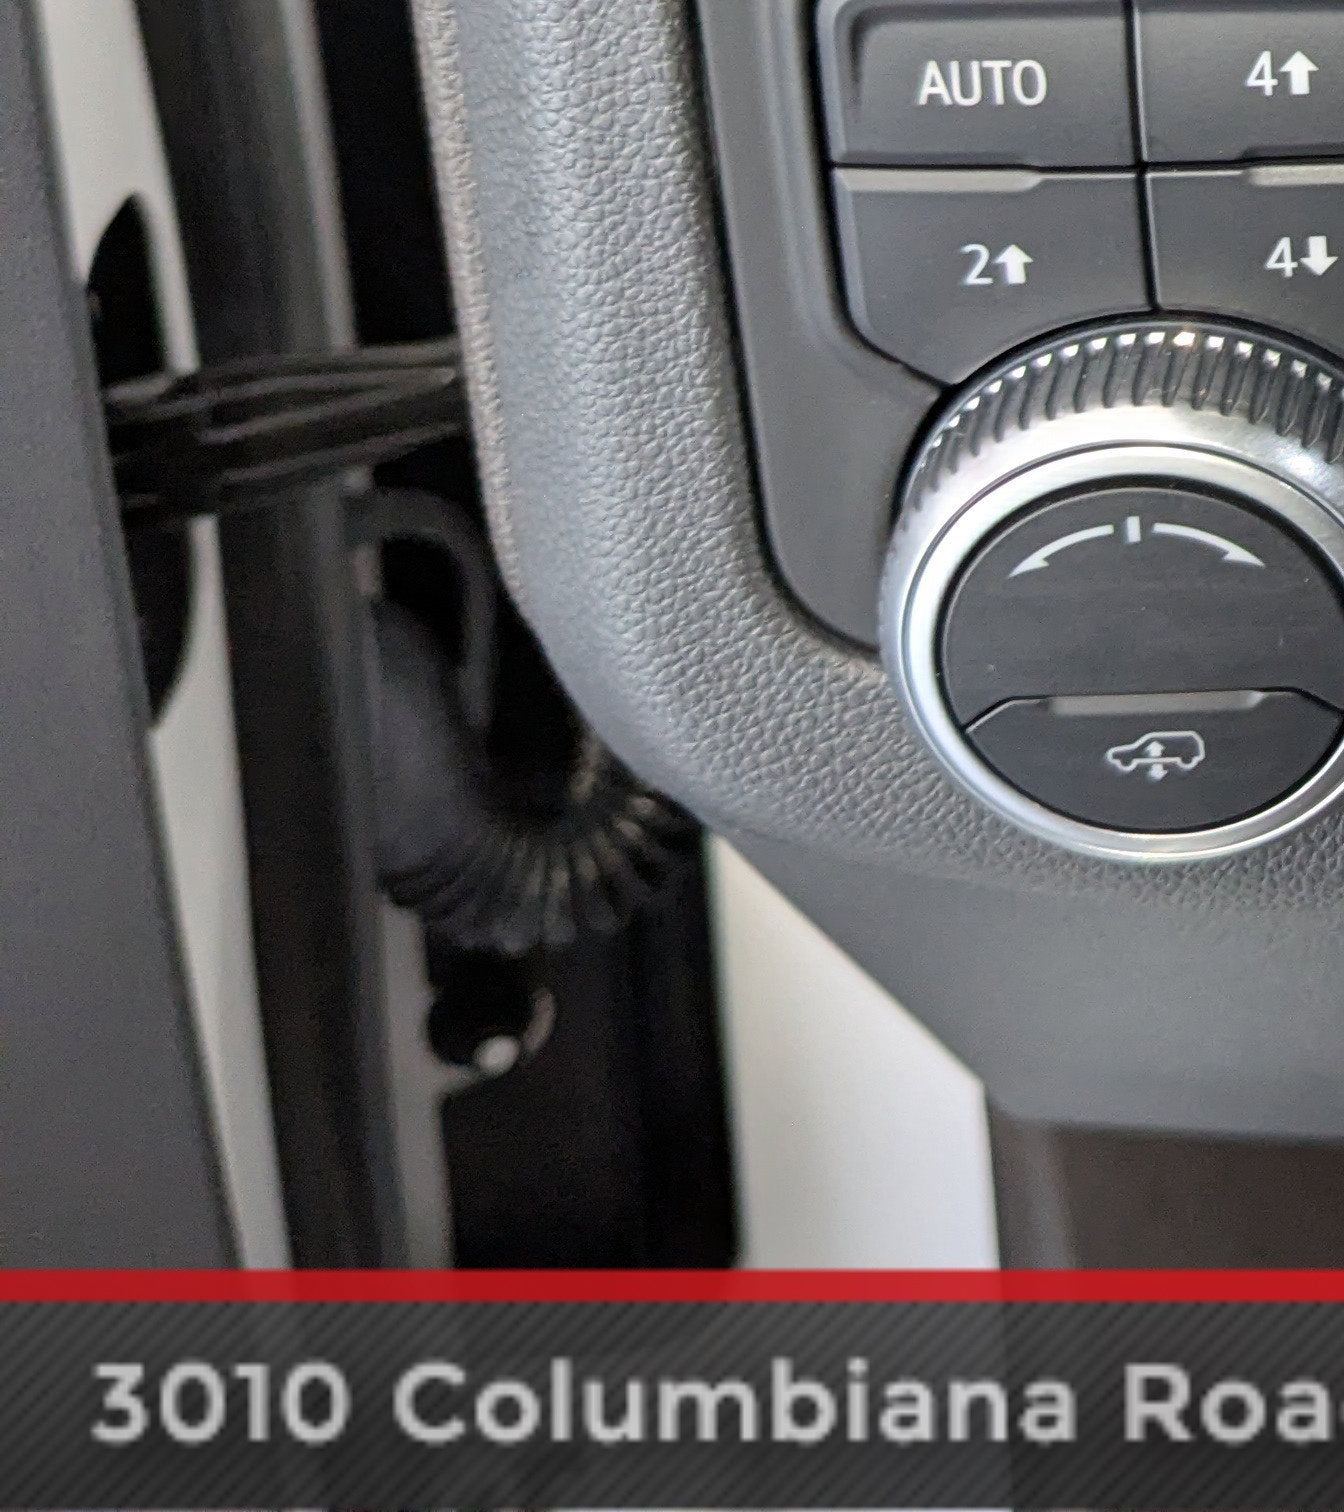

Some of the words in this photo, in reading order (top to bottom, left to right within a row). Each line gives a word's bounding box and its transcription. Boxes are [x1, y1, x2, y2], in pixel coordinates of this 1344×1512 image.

[917, 58, 1048, 107] AUTO
[1246, 49, 1279, 97] 4
[960, 242, 994, 287] 2
[1265, 235, 1299, 279] 4
